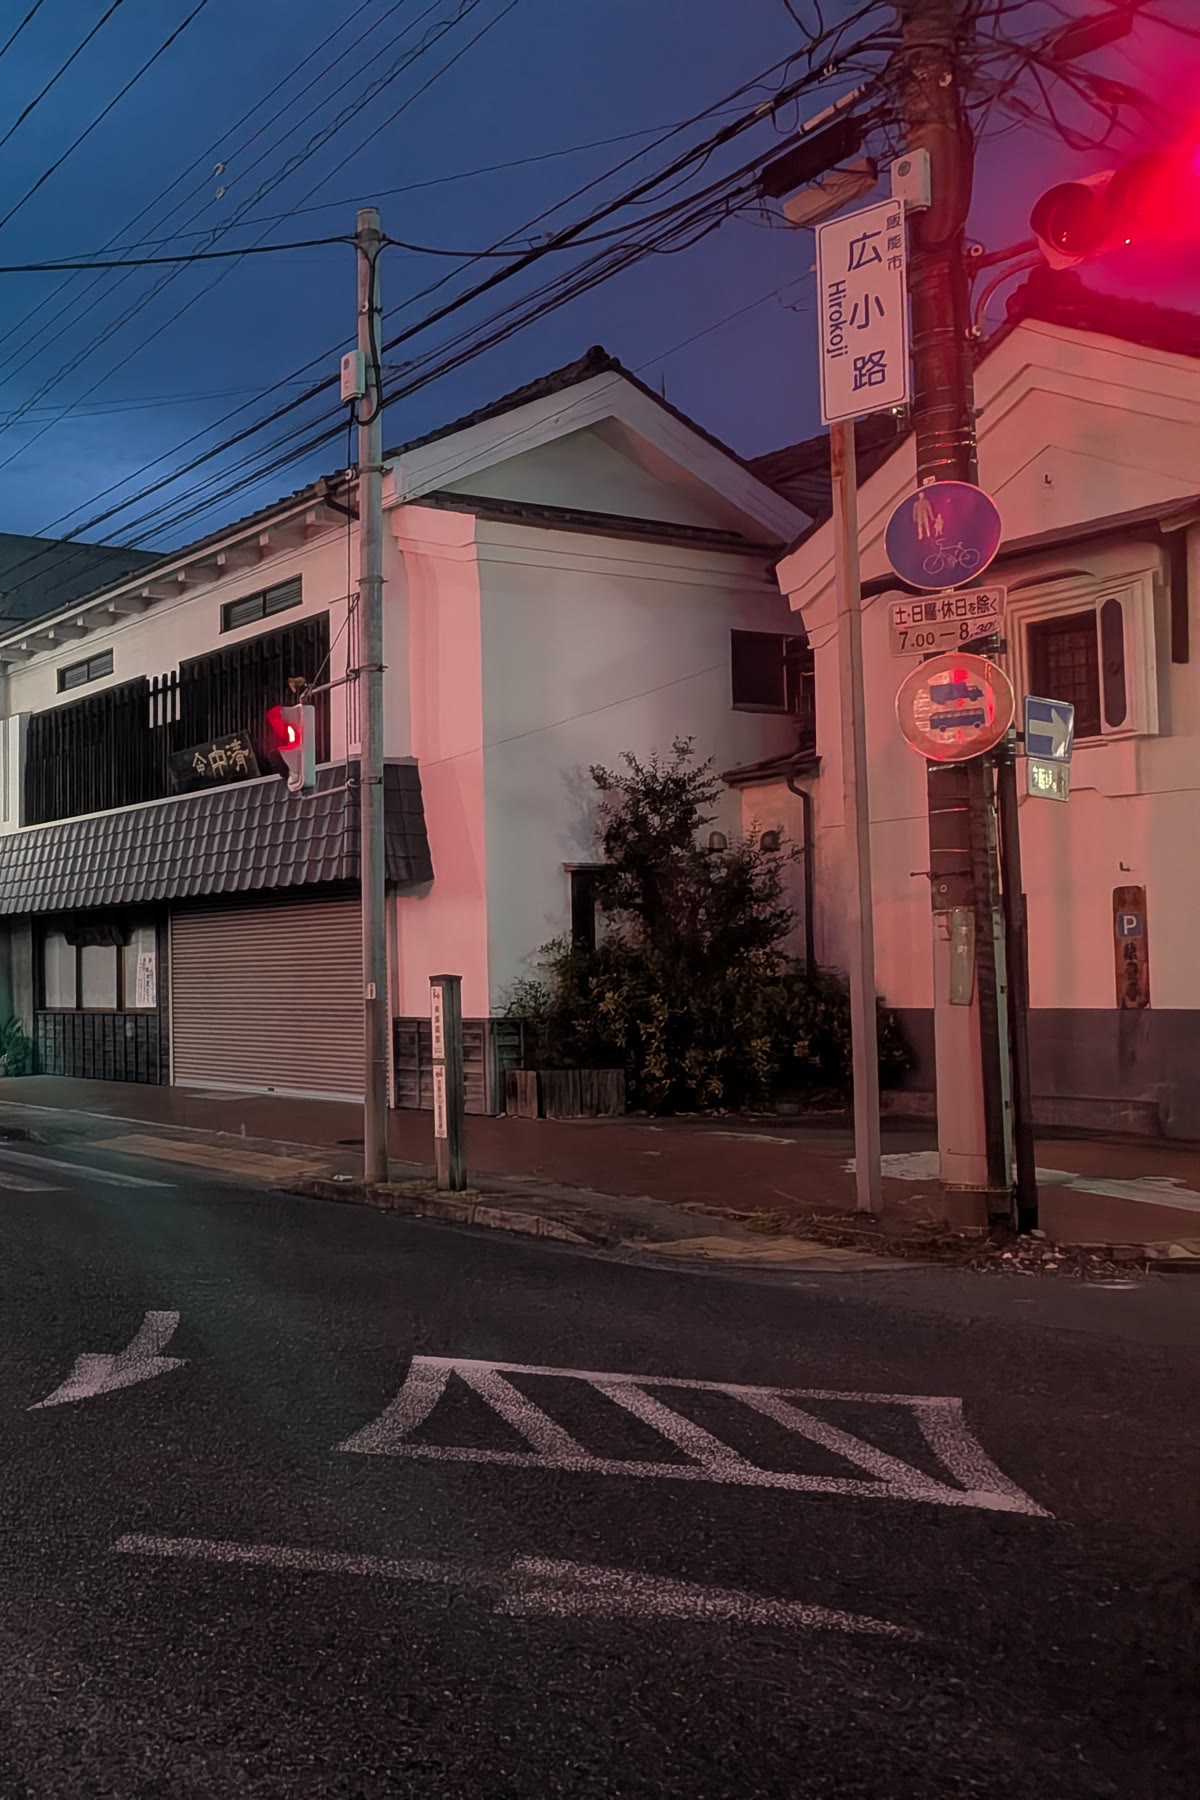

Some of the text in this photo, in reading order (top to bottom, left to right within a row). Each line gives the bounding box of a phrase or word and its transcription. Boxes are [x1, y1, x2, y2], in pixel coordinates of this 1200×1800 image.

[827, 279, 848, 359] Hirokoji
[847, 230, 887, 391] 広小路
[1123, 914, 1138, 936] P
